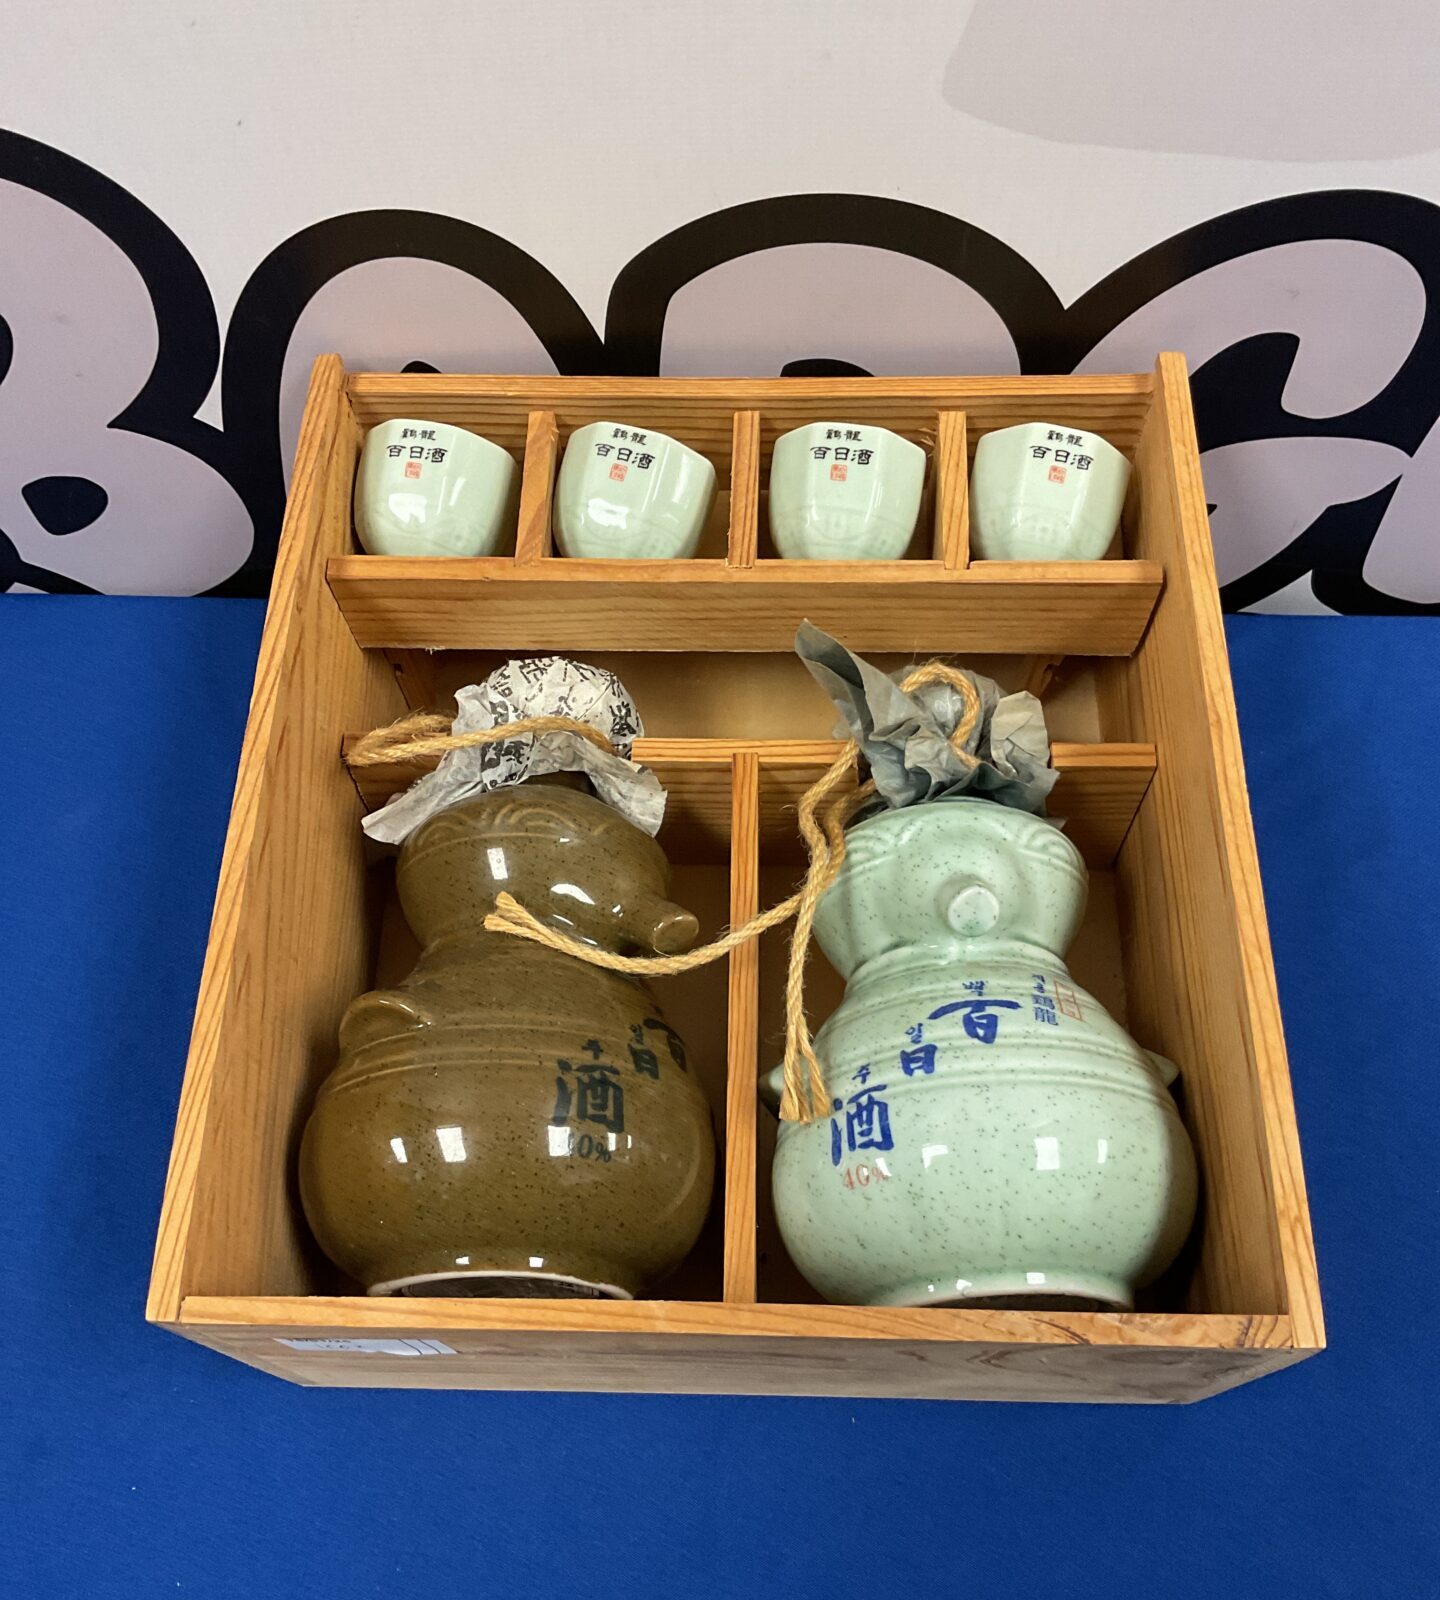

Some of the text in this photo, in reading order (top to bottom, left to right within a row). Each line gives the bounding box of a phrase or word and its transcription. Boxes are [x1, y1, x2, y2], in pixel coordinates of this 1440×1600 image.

[386, 444, 448, 463] 百日酒
[594, 443, 656, 469] 百日酒
[809, 445, 875, 465] 百日酒
[1029, 445, 1095, 470] 百日酒
[568, 1132, 613, 1164] 0%
